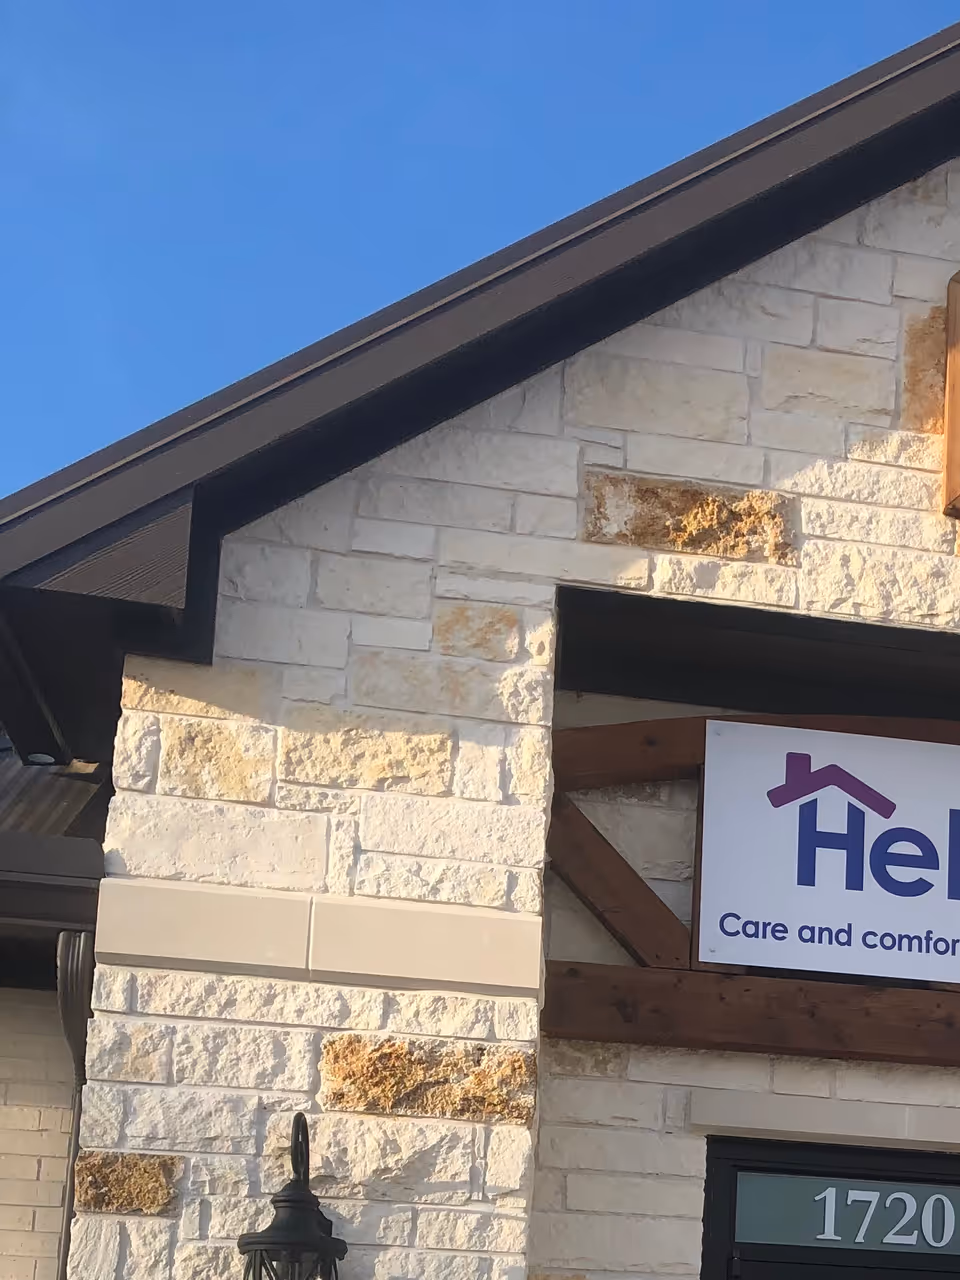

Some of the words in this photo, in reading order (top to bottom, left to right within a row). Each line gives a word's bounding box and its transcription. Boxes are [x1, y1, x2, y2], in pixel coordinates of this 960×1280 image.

[719, 912, 789, 941] Care
[798, 923, 852, 947] and
[813, 1186, 956, 1248] 1720
